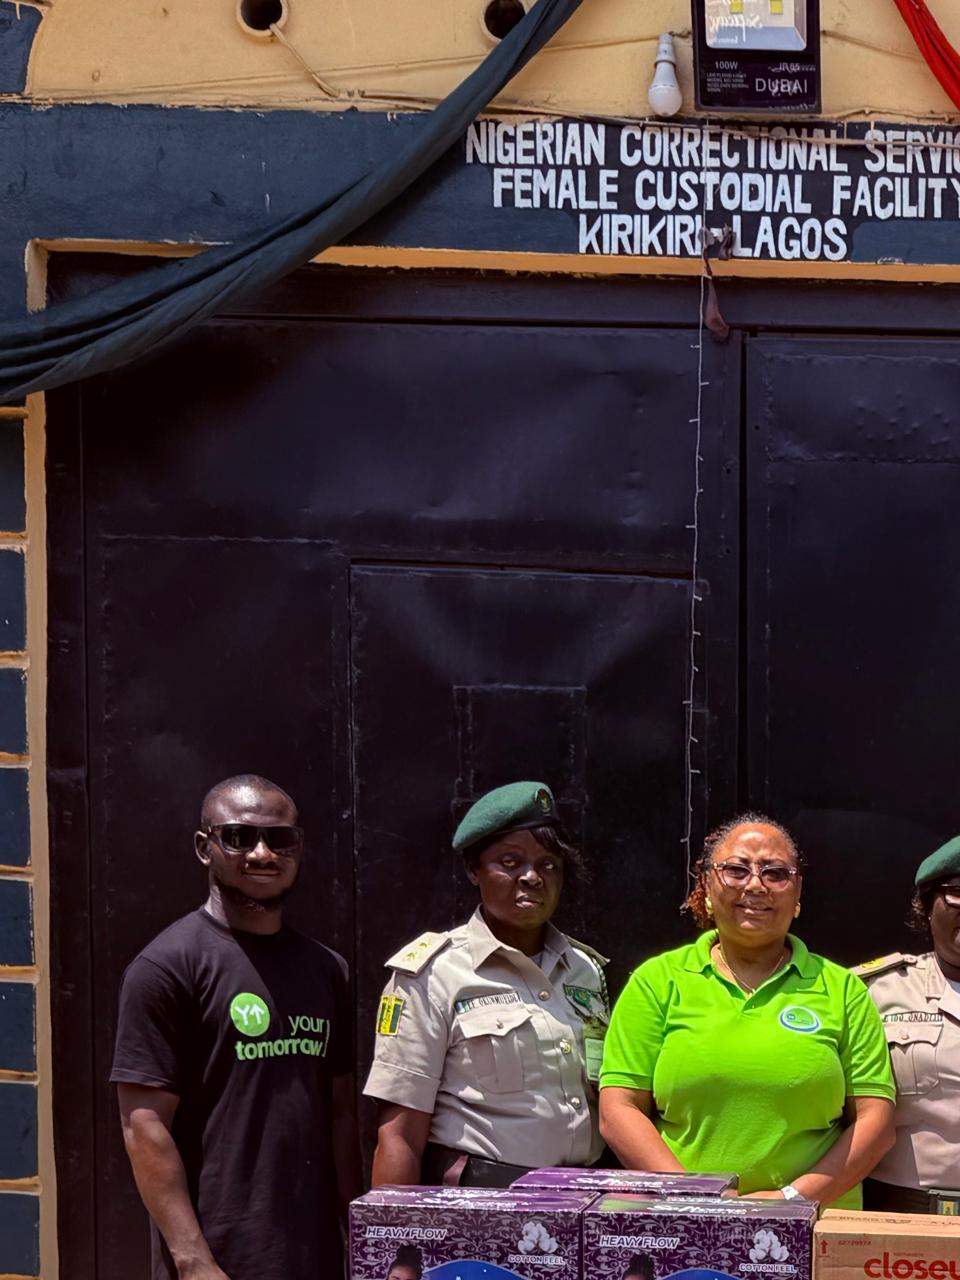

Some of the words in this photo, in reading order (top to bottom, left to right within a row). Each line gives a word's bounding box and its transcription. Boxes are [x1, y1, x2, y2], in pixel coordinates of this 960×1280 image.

[715, 61, 738, 69] 100W
[755, 79, 807, 93] DUBAI
[466, 121, 605, 165] NIGERIAN
[620, 125, 848, 171] CORRECTIONAL
[494, 169, 618, 209] FEMALE
[635, 169, 811, 214] CUSTODIAL
[579, 214, 703, 255] KIRIKIRI
[732, 215, 847, 260] LAGOS
[288, 1016, 324, 1036] your
[235, 1039, 323, 1060] tomorrow
[367, 1226, 410, 1239] HEAVY
[410, 1228, 447, 1239] FLOW
[600, 1236, 643, 1248] HEAVY
[643, 1237, 680, 1249] FLOW
